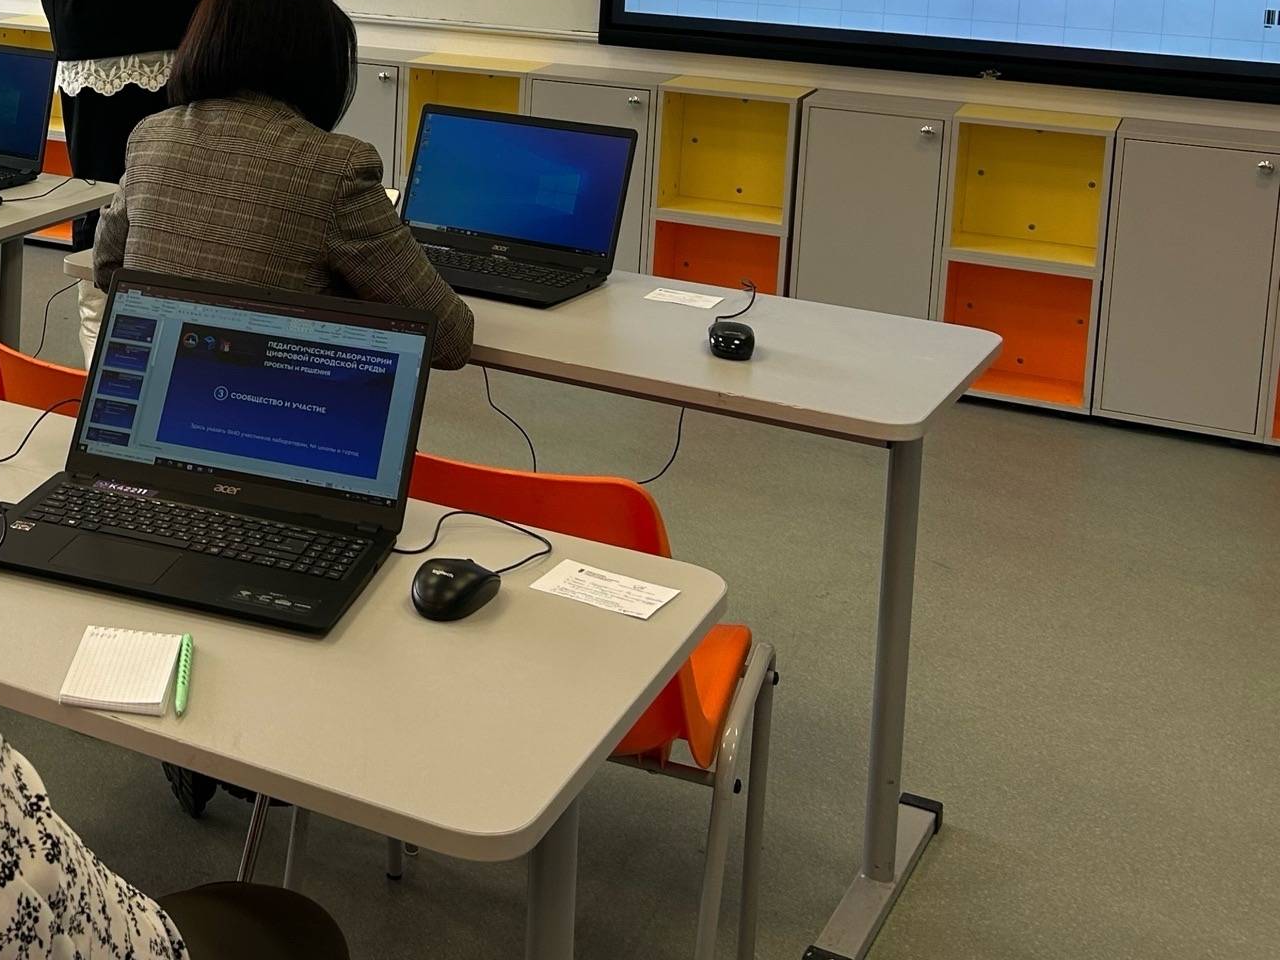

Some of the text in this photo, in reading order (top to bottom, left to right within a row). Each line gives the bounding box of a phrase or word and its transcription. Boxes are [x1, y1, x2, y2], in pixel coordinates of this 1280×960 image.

[266, 350, 386, 374] ЦИФРОВОЙ ГОРОДСКОЙ СРЕДЫ
[268, 341, 392, 365] ПЕДАГОГИЧЕСКИЕ ЛАБОРАТОРИИ
[264, 361, 293, 371] ПРОЕКТЫ
[300, 366, 331, 376] РЕШЕНИЯ
[231, 392, 283, 407] СООБЩЕСТВО
[292, 402, 327, 414] УЧАСТИЕ
[213, 483, 241, 495] acer
